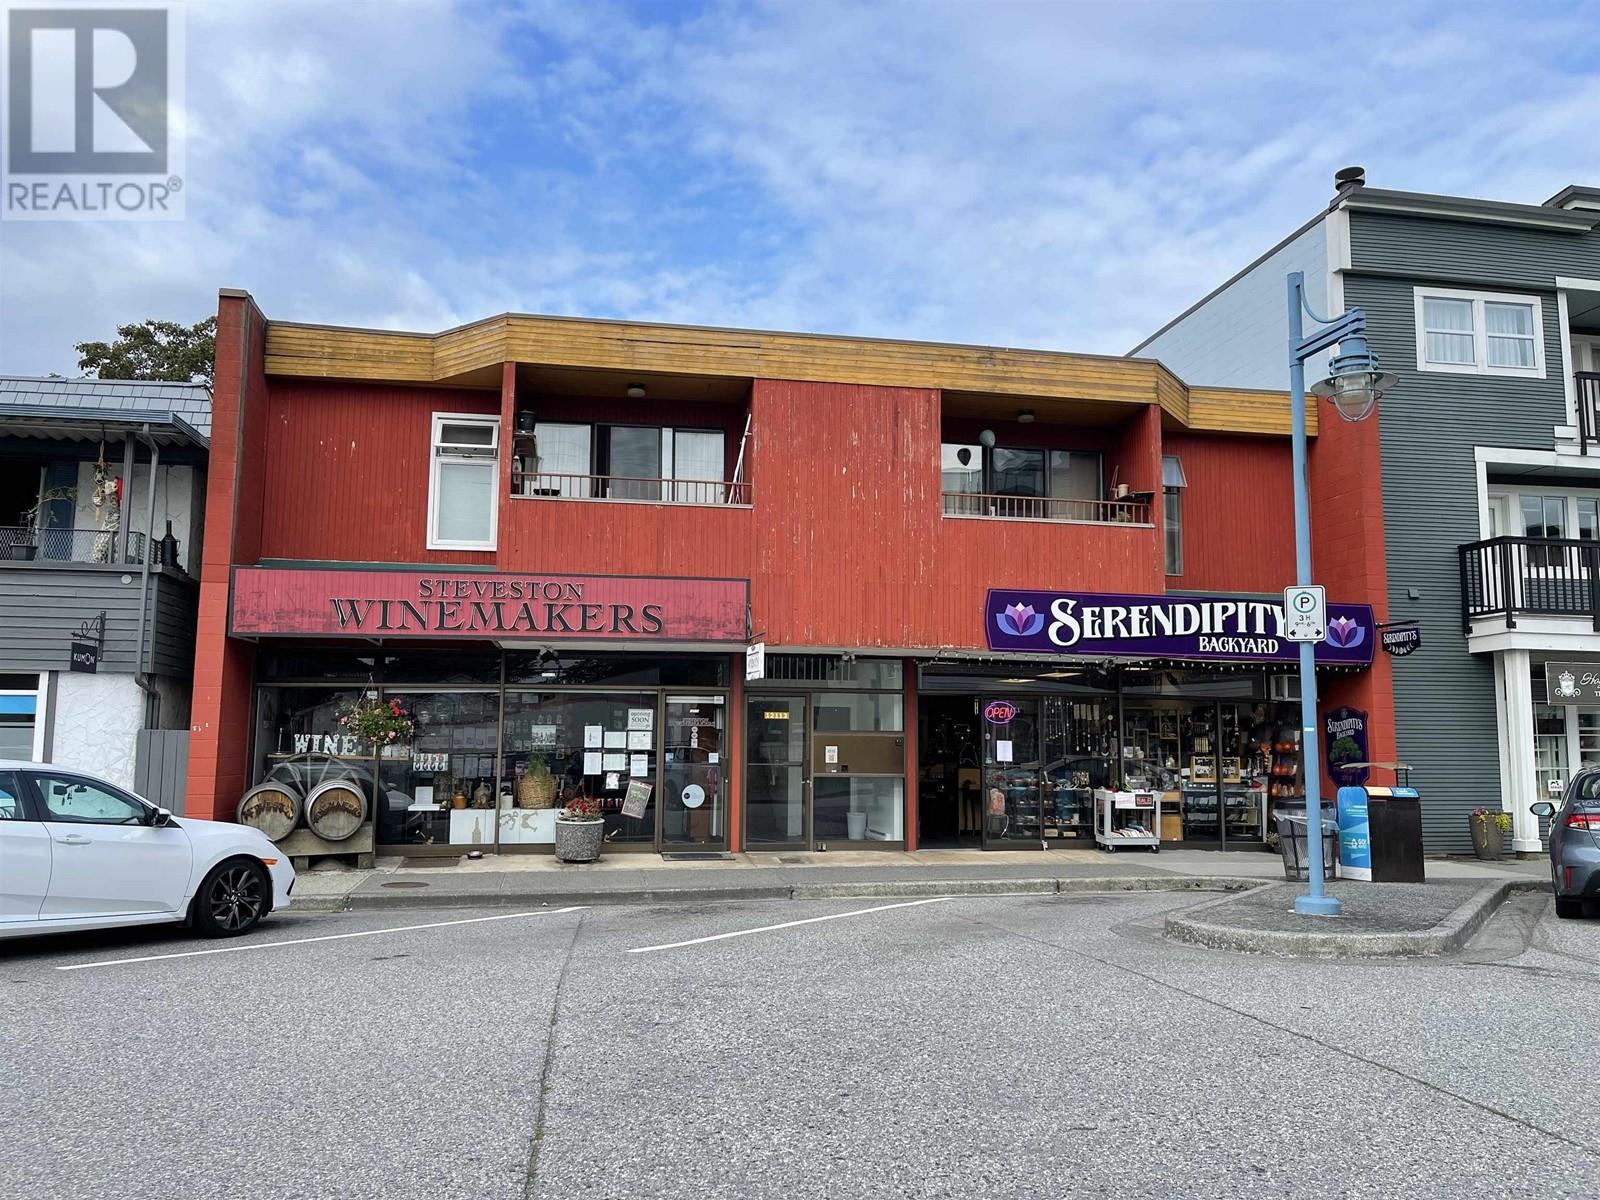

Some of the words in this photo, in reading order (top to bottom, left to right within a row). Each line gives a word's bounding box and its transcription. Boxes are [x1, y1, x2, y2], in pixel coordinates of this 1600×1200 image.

[418, 578, 585, 600] STEVESTON
[329, 598, 665, 634] WINEMAKERS
[1047, 598, 1290, 647] SERENDIPITY
[1199, 636, 1279, 655] BACKYARD
[73, 653, 96, 665] KUMON
[986, 707, 1013, 719] OPEN
[294, 733, 358, 756] WINE
